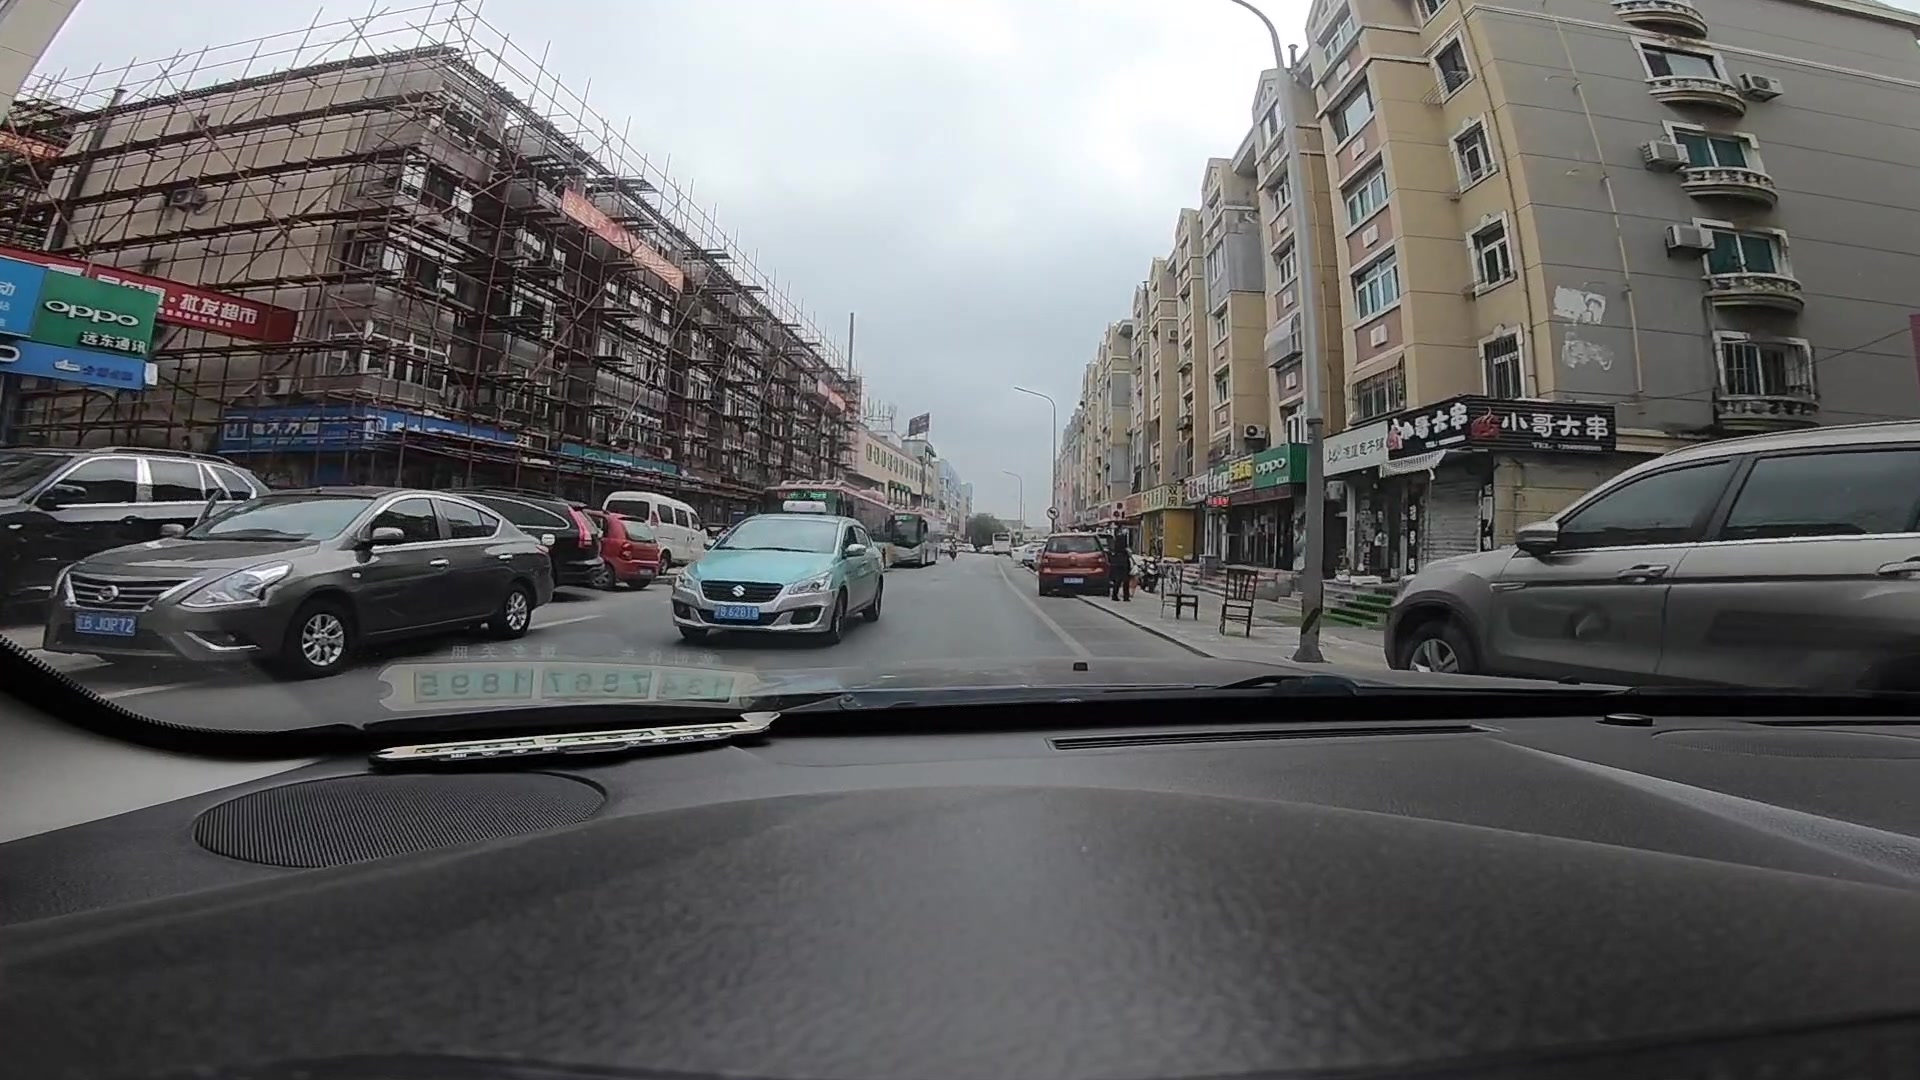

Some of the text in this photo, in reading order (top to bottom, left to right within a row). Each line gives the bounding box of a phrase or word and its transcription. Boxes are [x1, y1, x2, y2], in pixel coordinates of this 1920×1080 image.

[81, 331, 147, 354] 远东通讯
[1501, 412, 1608, 440] 小哥大串
